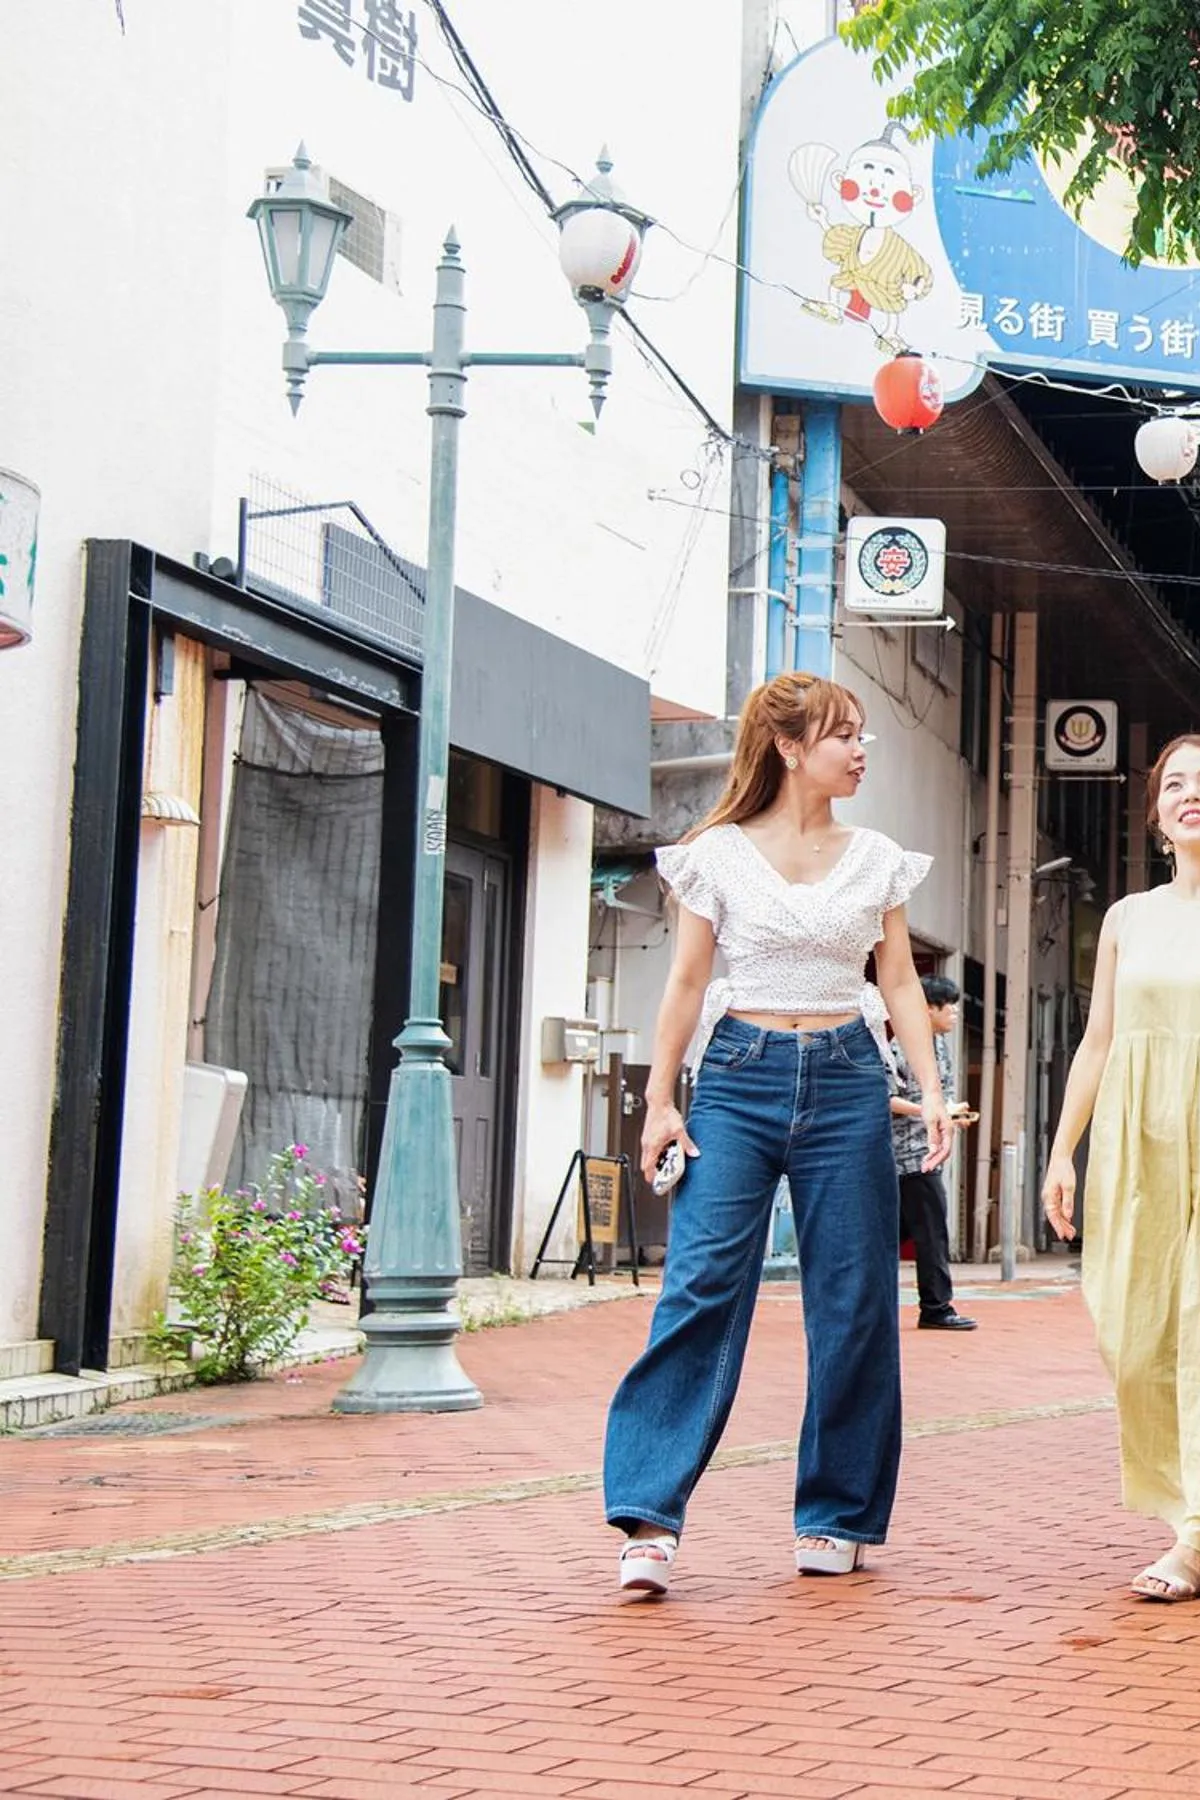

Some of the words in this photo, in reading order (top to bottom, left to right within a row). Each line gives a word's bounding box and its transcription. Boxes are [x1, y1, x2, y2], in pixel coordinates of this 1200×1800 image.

[955, 291, 1065, 342] 見る街
[1087, 308, 1200, 359] 買う街
